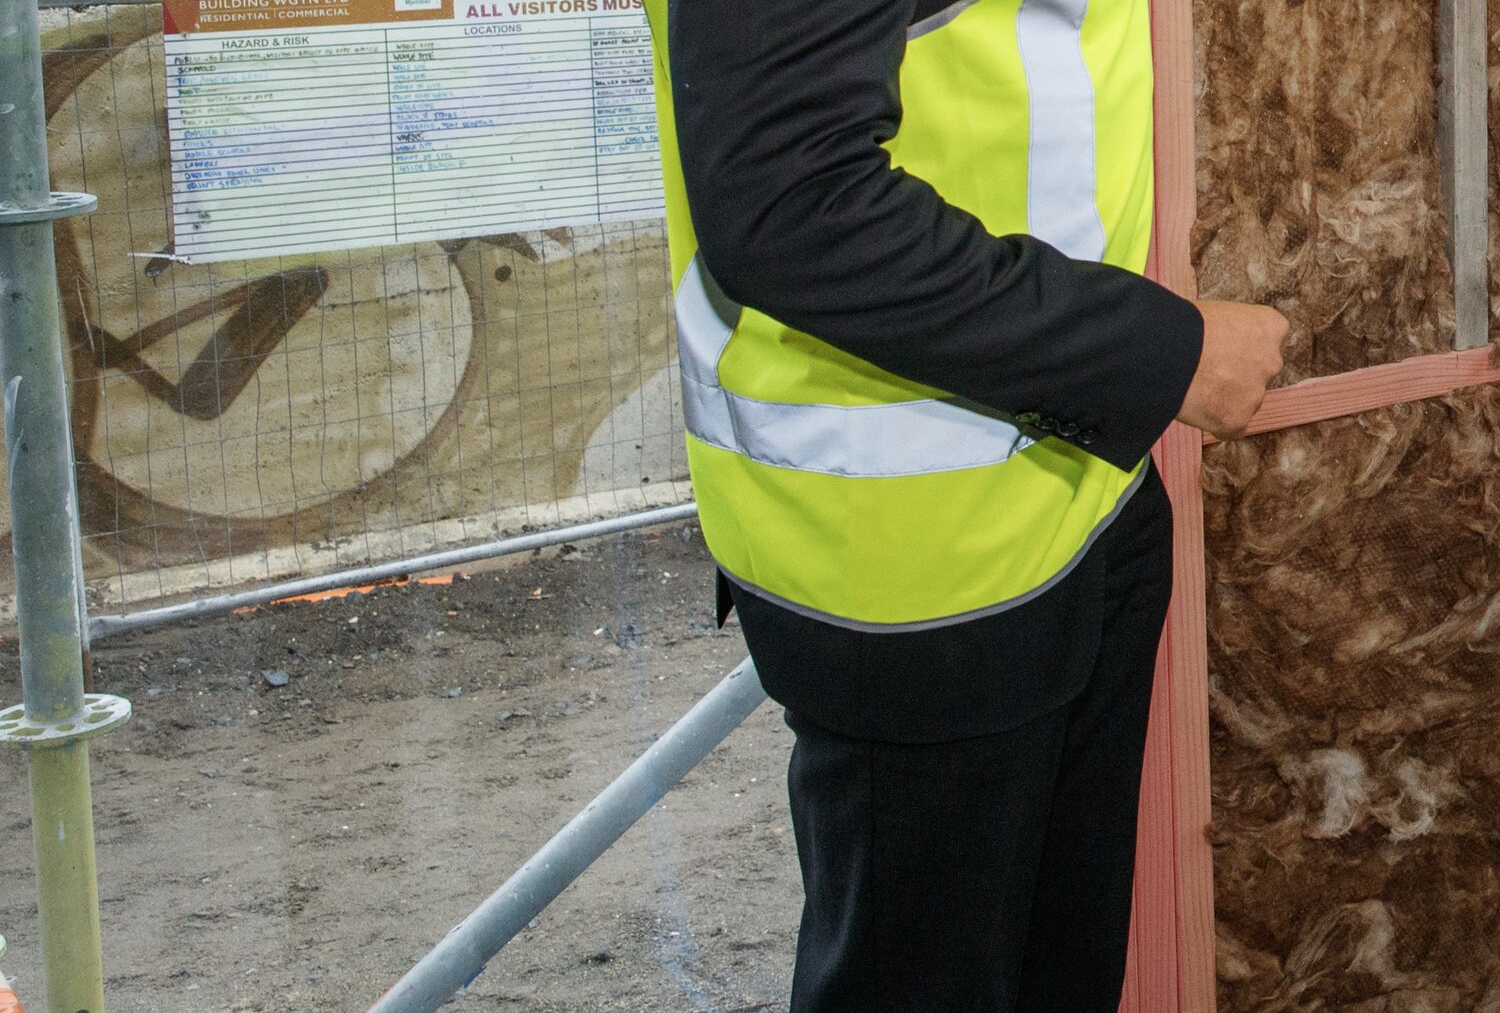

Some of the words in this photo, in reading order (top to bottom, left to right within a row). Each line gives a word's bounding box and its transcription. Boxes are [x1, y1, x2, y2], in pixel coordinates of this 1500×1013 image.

[200, 12, 270, 23] RESIDENTIAL
[279, 9, 350, 18] COMMERCIAL
[466, 4, 502, 18] ALL
[464, 24, 522, 35] LOCATIONS
[222, 38, 269, 49] HAZARD
[272, 38, 280, 46] &
[283, 37, 310, 45] RISK
